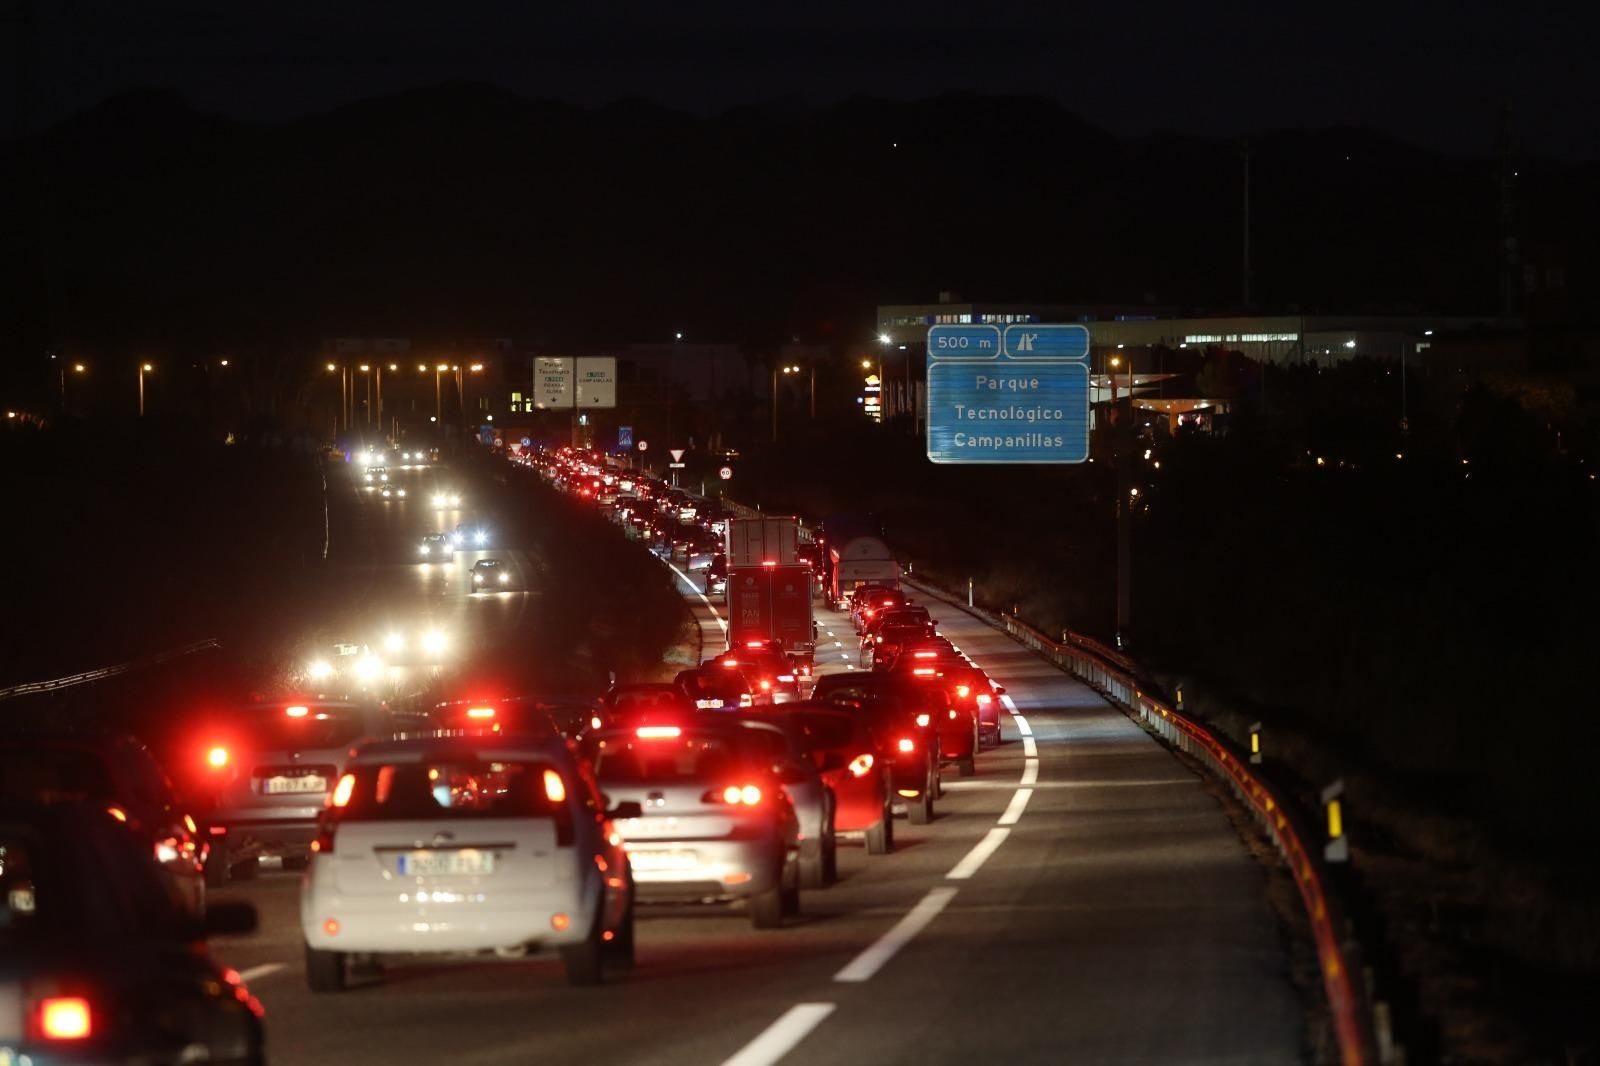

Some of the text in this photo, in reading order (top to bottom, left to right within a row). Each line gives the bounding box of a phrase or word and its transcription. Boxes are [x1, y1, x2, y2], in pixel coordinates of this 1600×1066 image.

[938, 336, 991, 349] 500 m
[976, 375, 1040, 392] Parque
[954, 404, 1063, 422] Tecnológico
[954, 432, 1063, 450] Campanillas
